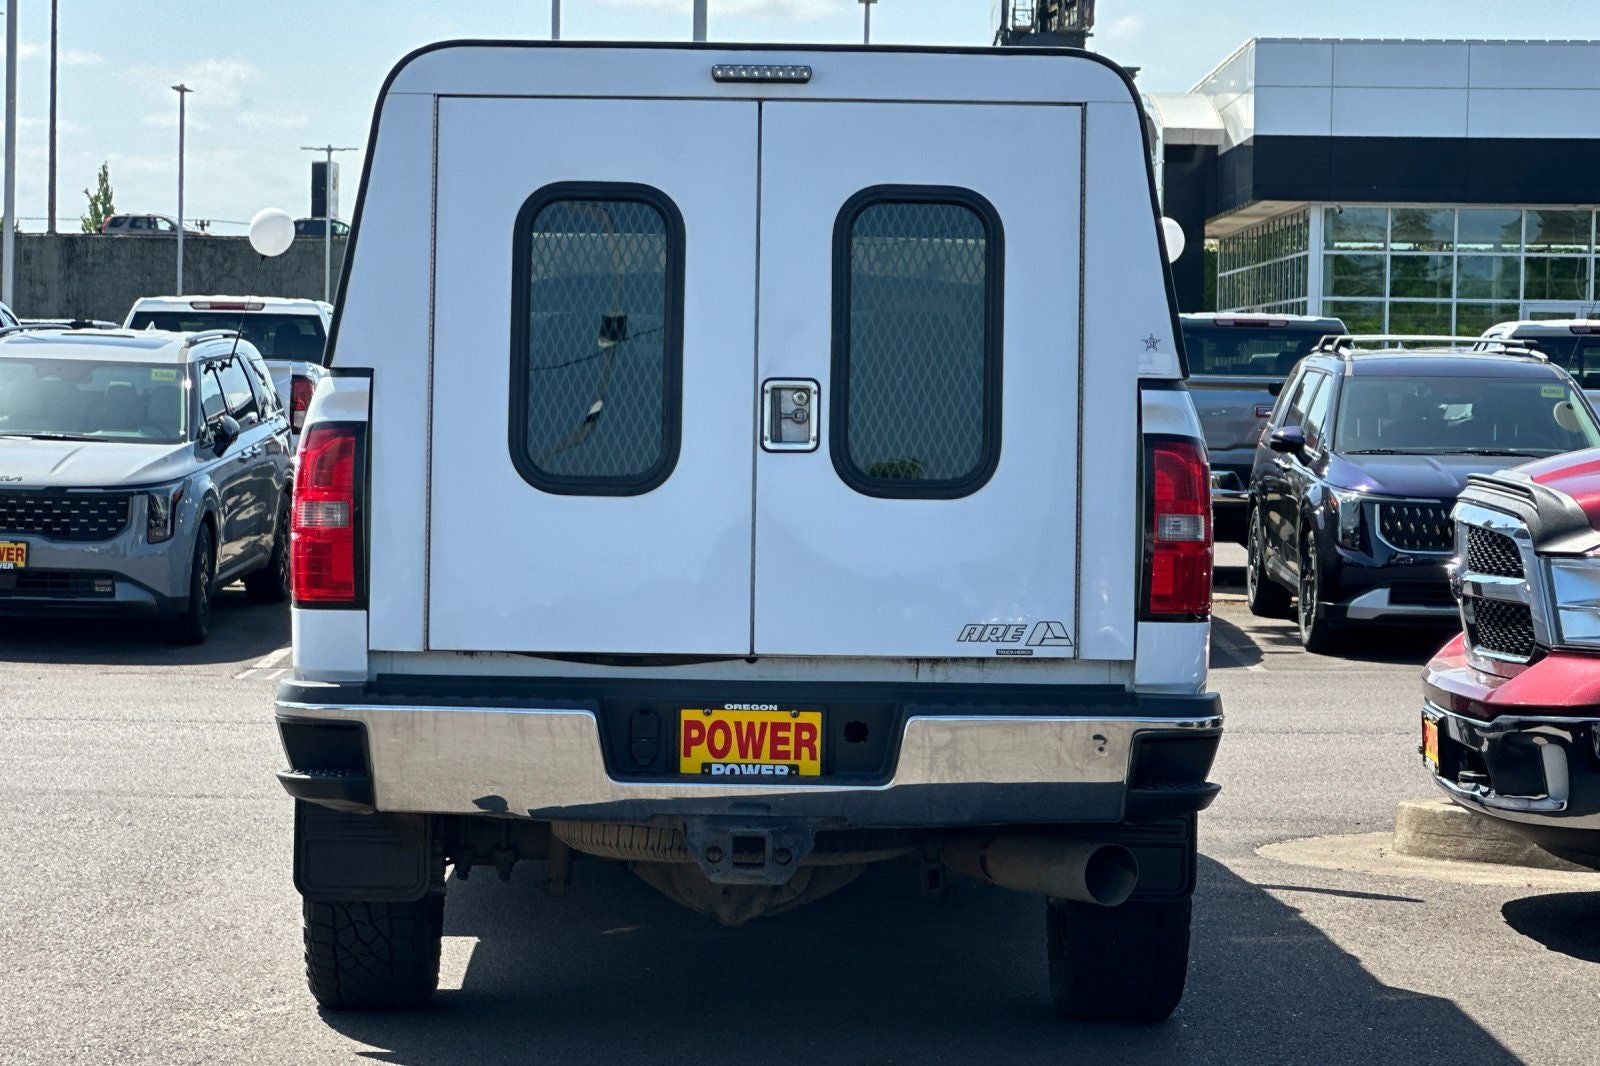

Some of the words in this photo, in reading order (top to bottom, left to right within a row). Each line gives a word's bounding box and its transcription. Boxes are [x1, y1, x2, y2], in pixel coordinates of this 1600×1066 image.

[957, 624, 1028, 642] ARE
[724, 703, 778, 711] OREGON
[683, 719, 818, 761] POWER
[711, 763, 789, 775] POWER
